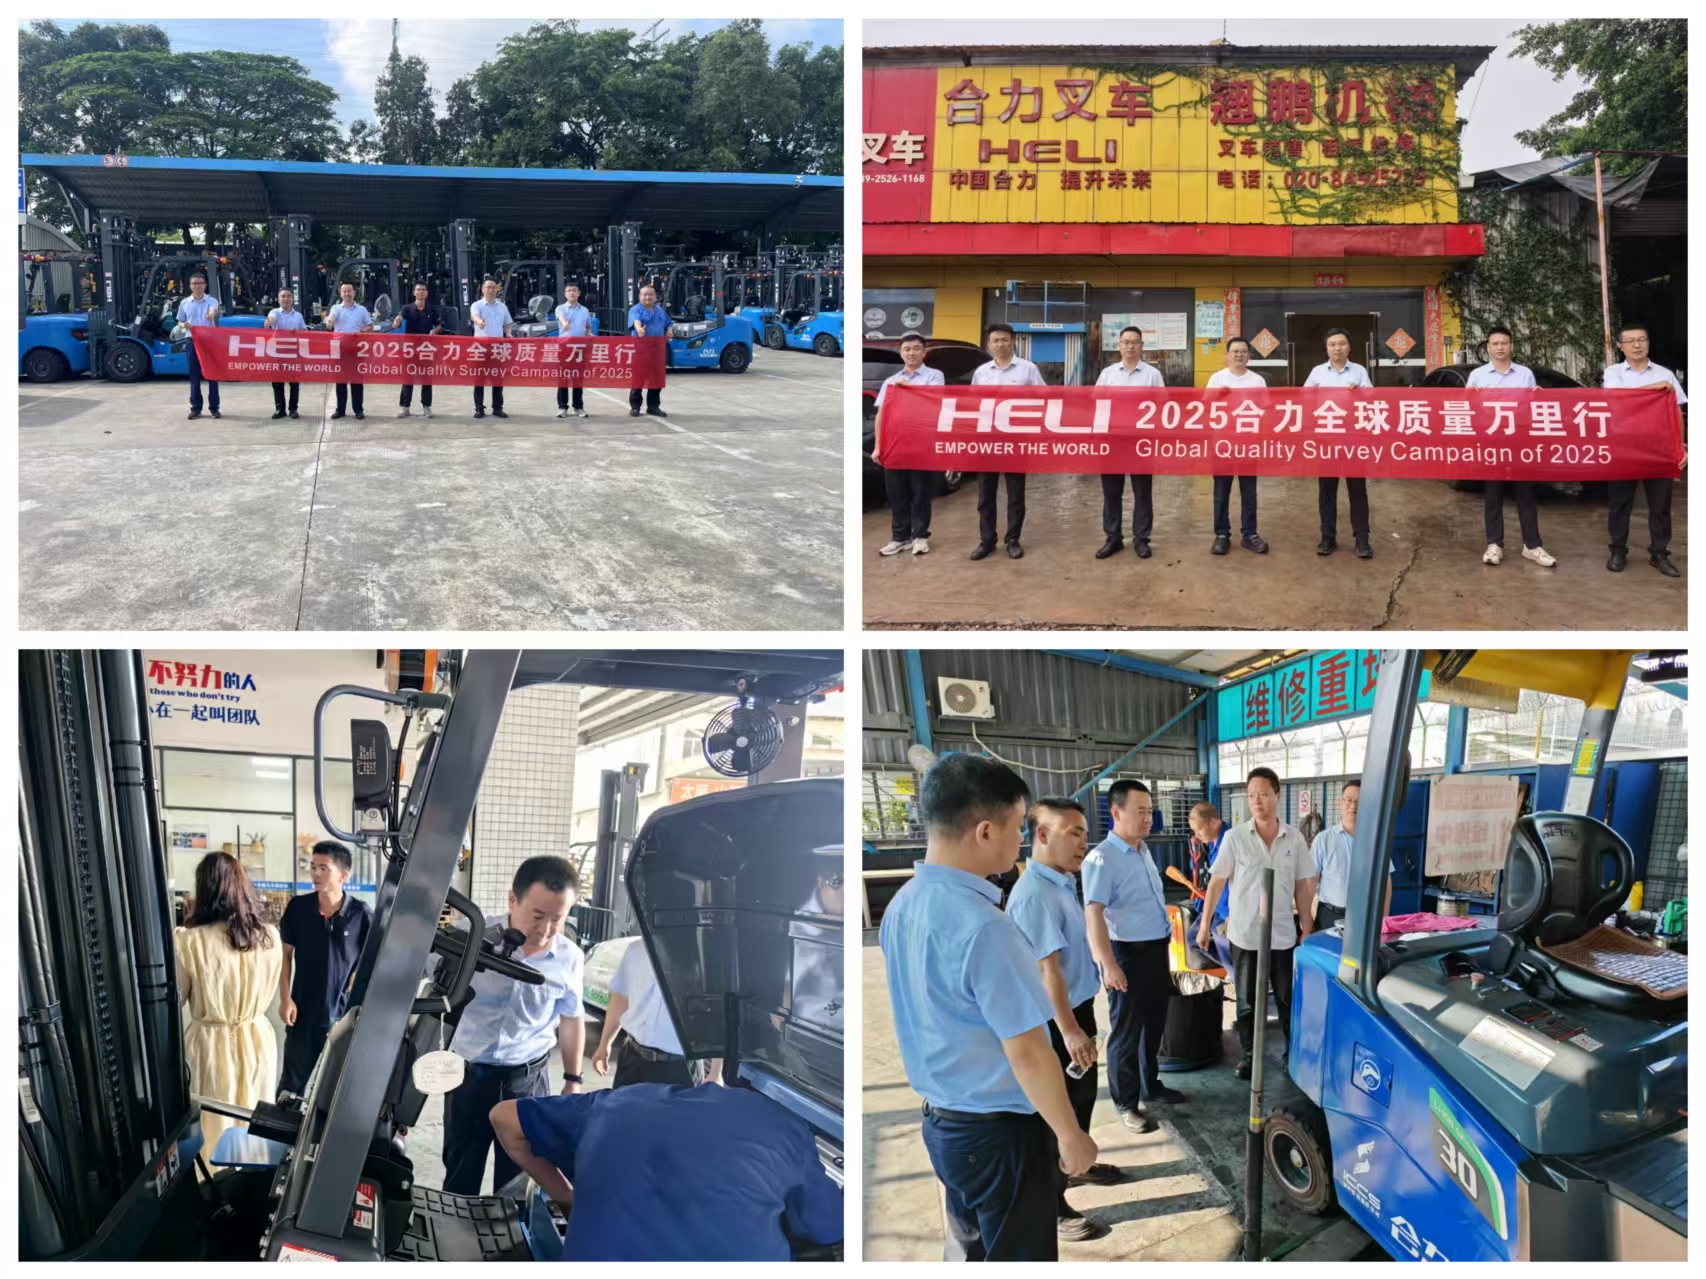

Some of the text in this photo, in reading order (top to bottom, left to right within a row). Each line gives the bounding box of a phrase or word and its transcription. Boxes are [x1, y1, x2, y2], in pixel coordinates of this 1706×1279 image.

[943, 78, 1153, 126] 合力叉车
[862, 130, 925, 165] 叉车
[978, 138, 1117, 163] HELI
[950, 169, 1152, 190] 中国合力 提升未来
[229, 336, 340, 359] HELI
[357, 341, 636, 364] 2025合力全球质量万里行
[228, 362, 341, 373] EMPOWER THE WORLD
[357, 363, 633, 379] Global Quality Survey Campaign of 2025
[937, 398, 1111, 434] HELI
[1136, 399, 1612, 438] 2025合力全球质量万里行
[935, 442, 1110, 456] EMPOWER THE WORLD
[1136, 439, 1612, 465] Global Quality Survey Campaign of 2025
[148, 660, 256, 691] 不努力的人
[150, 688, 241, 703] those who don't try
[149, 701, 260, 726] 在一起叫团队
[1438, 1128, 1477, 1200] 30
